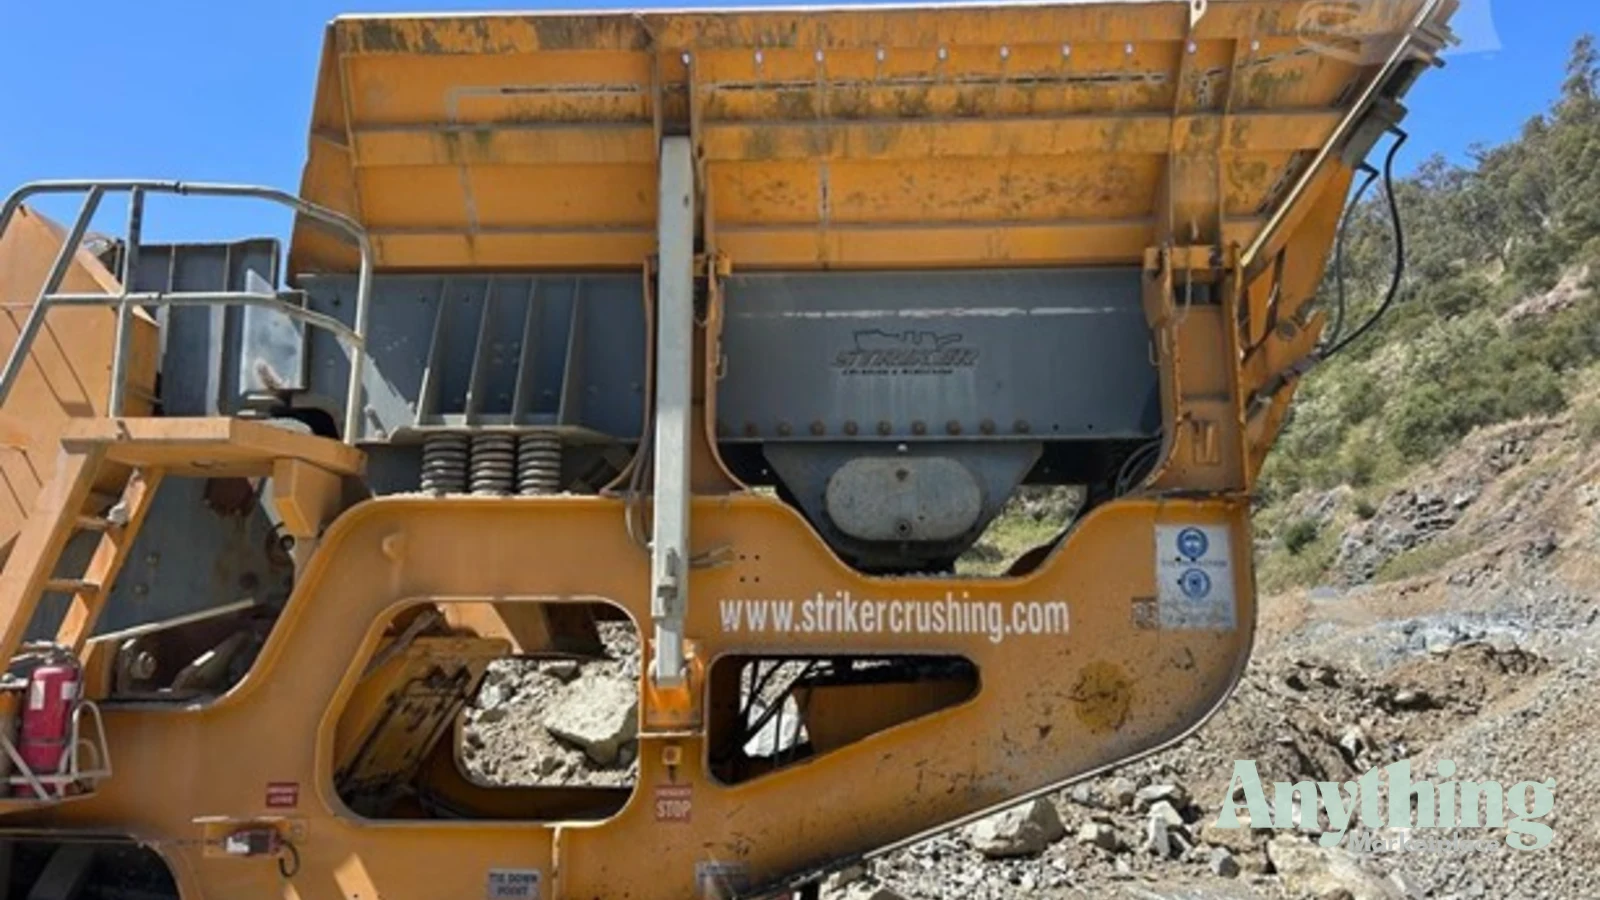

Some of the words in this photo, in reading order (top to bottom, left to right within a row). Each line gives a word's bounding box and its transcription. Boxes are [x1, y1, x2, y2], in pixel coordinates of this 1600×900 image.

[719, 591, 1070, 642] www.strikercrushing.com
[655, 799, 692, 818] STOP
[488, 872, 505, 883] TIE
[507, 872, 538, 883] DOWN
[497, 885, 529, 896] POINT
